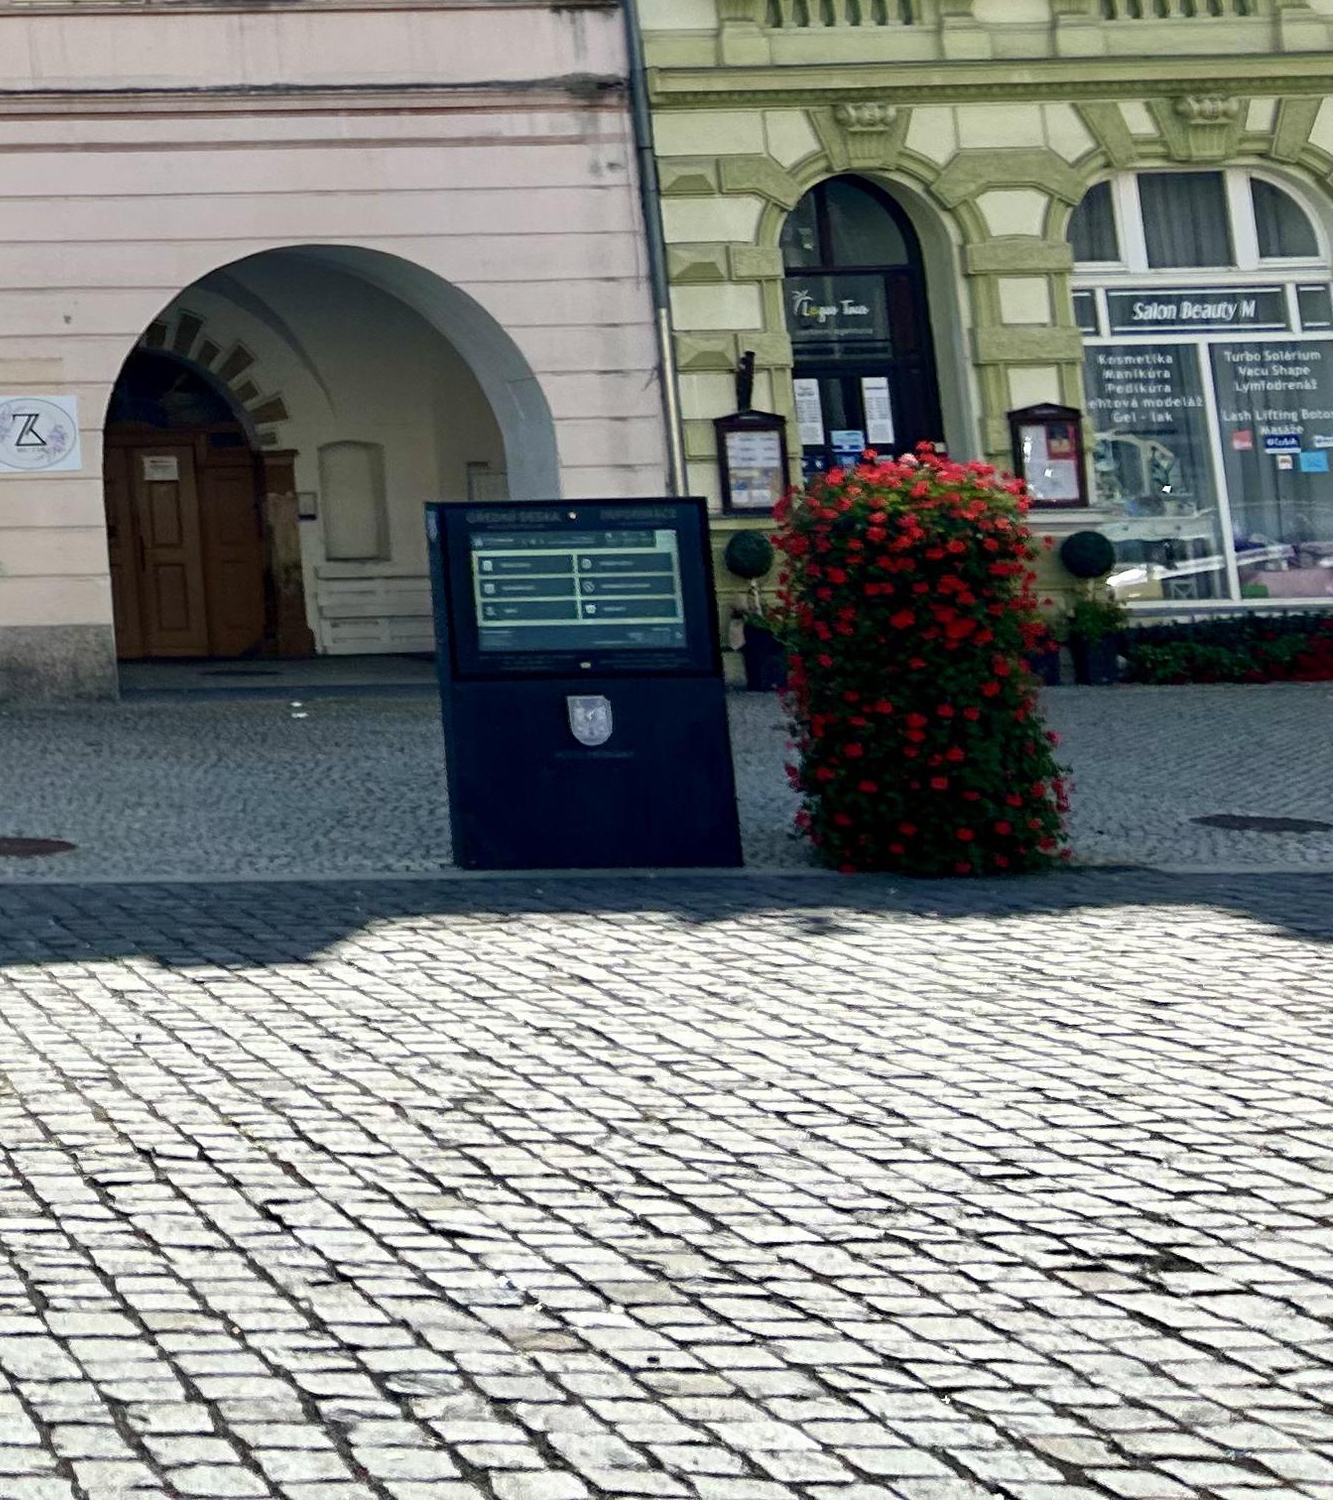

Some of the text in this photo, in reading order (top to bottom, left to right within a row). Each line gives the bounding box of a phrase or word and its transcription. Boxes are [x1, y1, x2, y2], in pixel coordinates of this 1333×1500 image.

[1132, 299, 1256, 321] Salon Beauty M
[1097, 353, 1174, 365] Kosmetika
[1224, 350, 1261, 362] Turbo
[1102, 368, 1172, 380] Manikúra
[1237, 364, 1311, 377] Vacu Shape
[1105, 382, 1172, 394] Pedikúra
[1112, 411, 1137, 424] Gel
[1151, 410, 1174, 422] lak
[1223, 409, 1252, 422] Lash
[1255, 408, 1299, 423] Lifting
